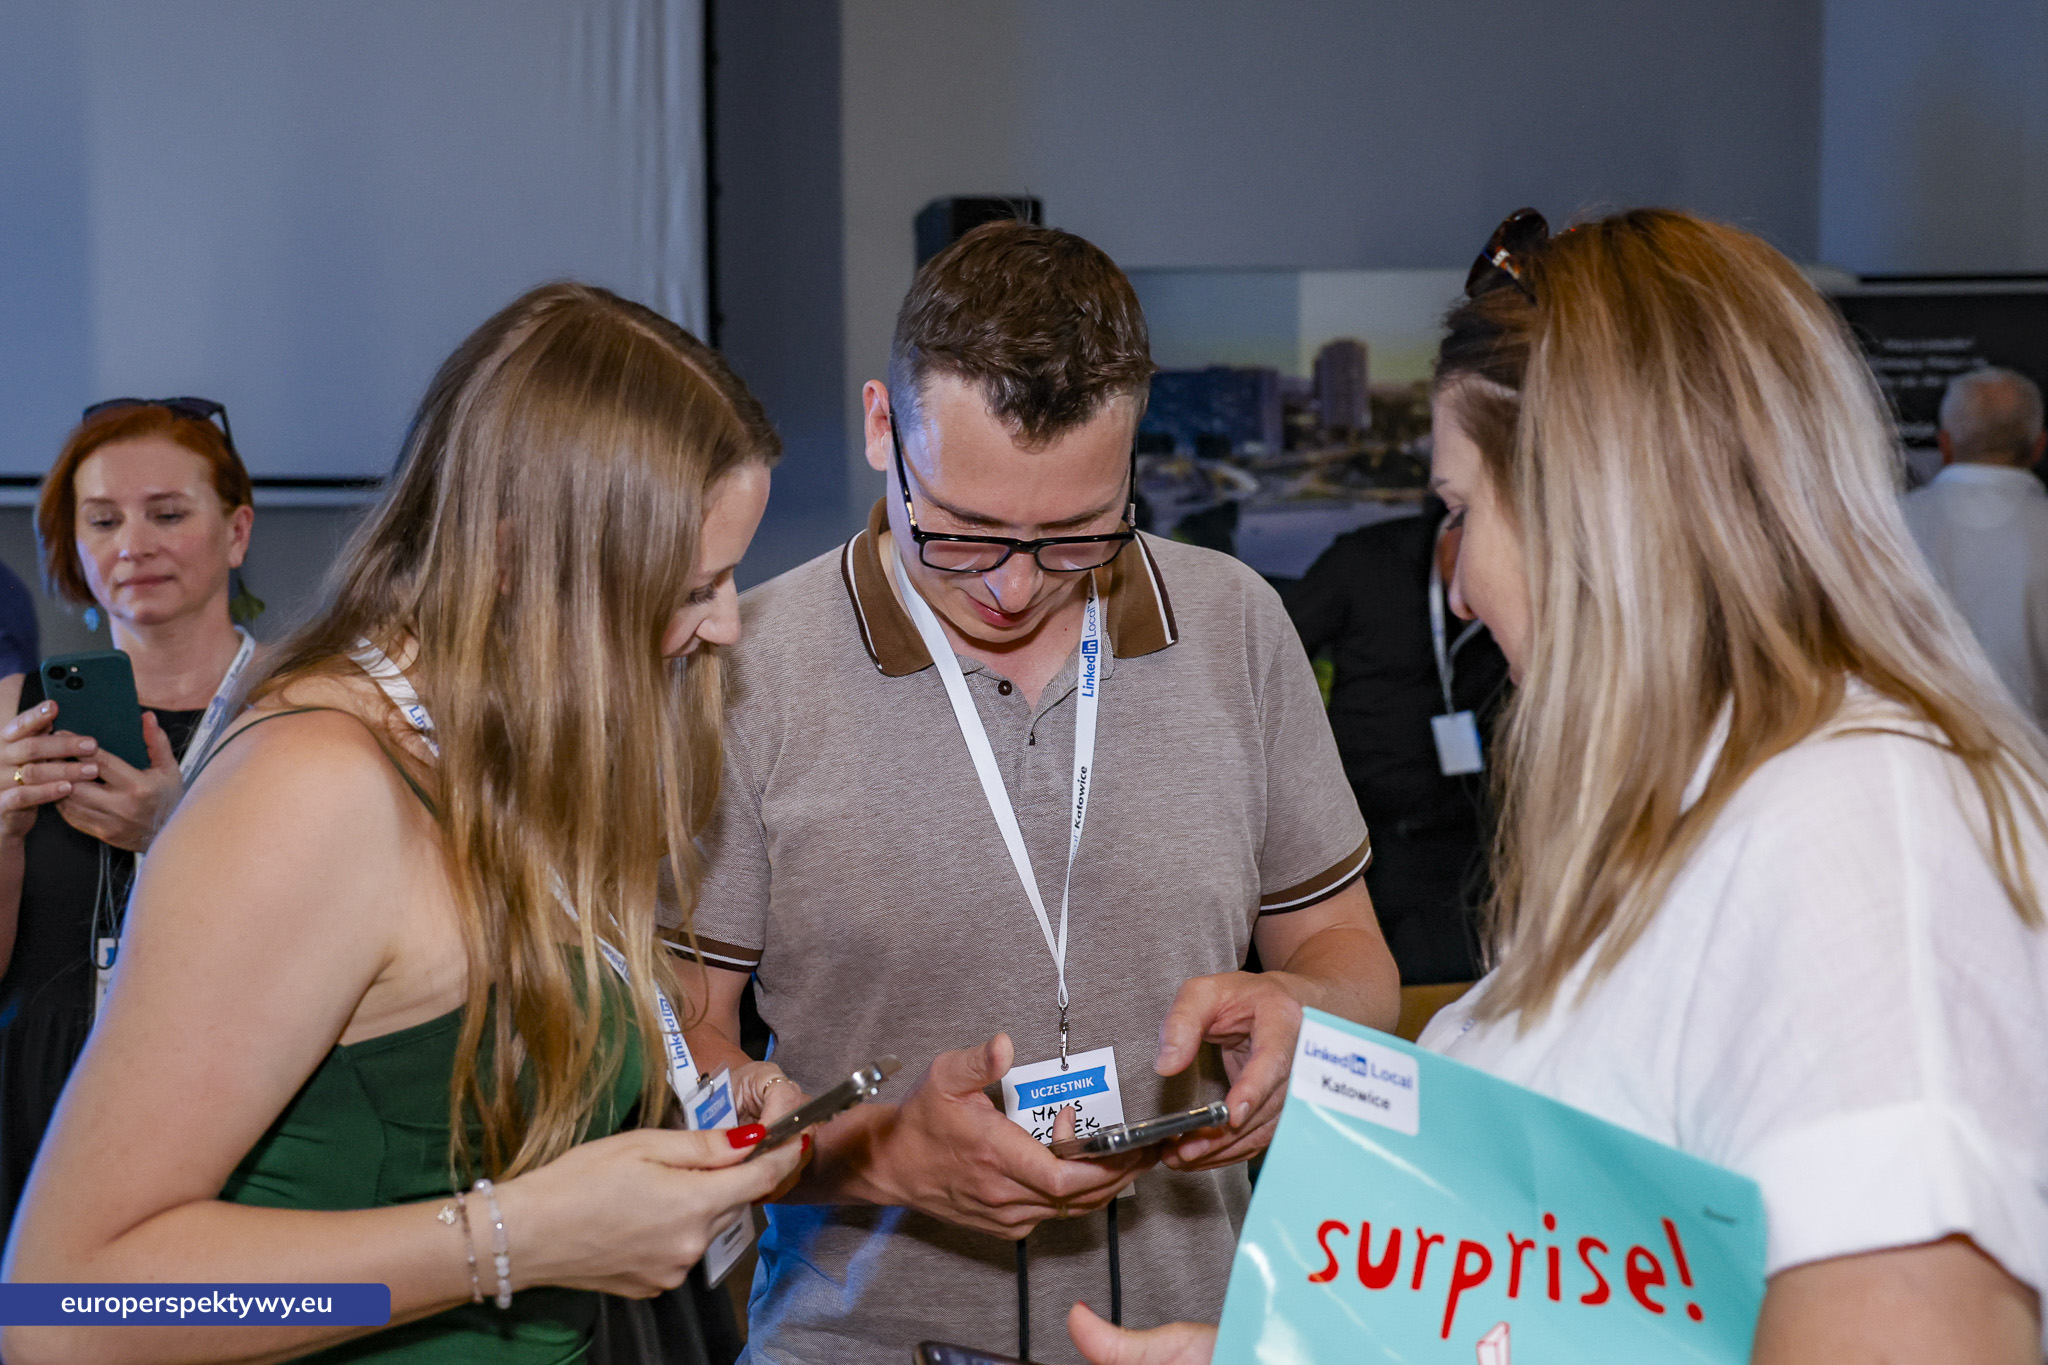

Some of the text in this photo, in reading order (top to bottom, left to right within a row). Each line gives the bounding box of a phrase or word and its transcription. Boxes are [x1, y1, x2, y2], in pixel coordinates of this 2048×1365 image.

[1074, 766, 1088, 830] Katowice
[1030, 1076, 1095, 1100] UCZESTNIK
[1321, 1076, 1391, 1110] Katowice
[1371, 1062, 1413, 1090] Local
[1308, 1213, 1704, 1339] surprise!
